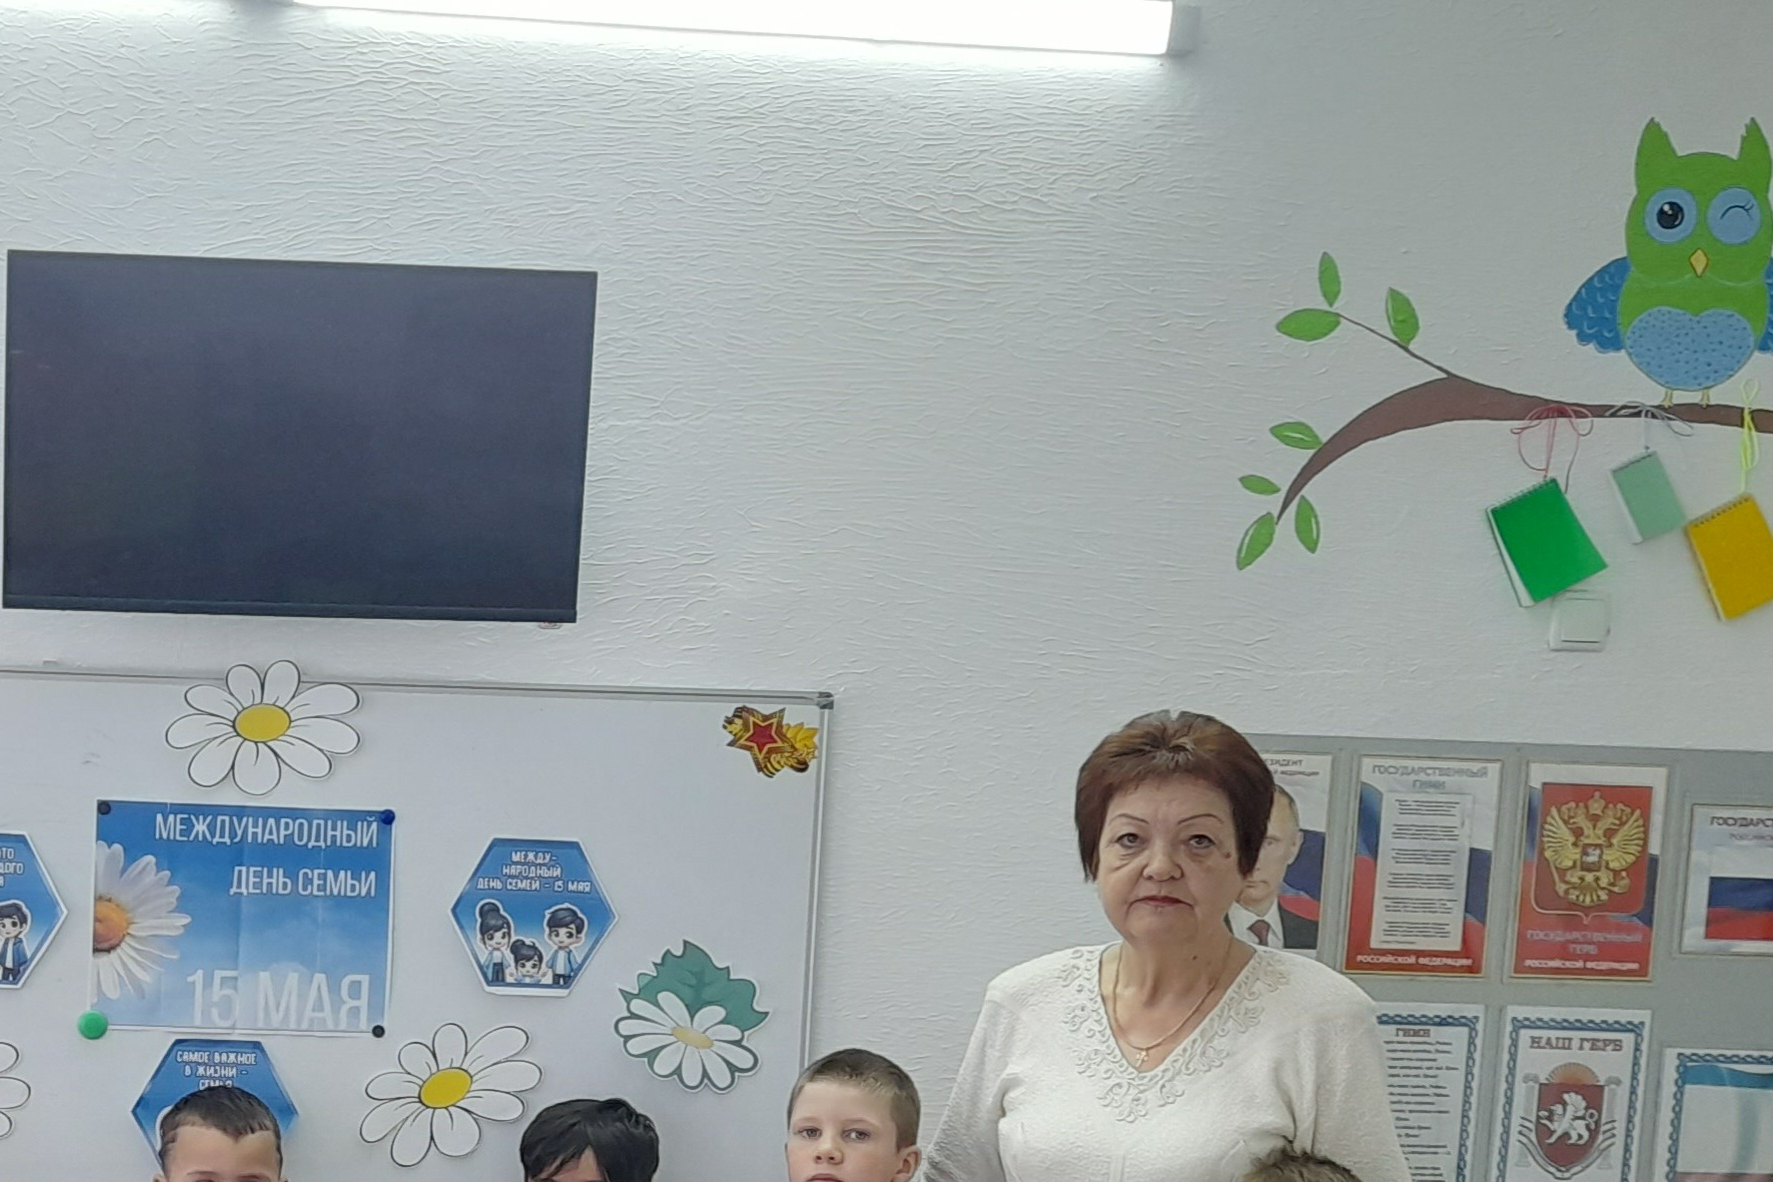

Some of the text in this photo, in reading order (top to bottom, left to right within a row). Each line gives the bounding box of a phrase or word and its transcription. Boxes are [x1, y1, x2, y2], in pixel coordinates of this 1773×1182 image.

[155, 813, 378, 849] МЕЖДУНАРОДНЫЙ
[511, 851, 558, 863] МЕЖДУ-
[502, 865, 561, 878] НАРОДНЫЙ
[230, 866, 376, 897] ДЕНЬ СЕМЬИ
[477, 878, 503, 890] ДЕНЬ
[506, 877, 540, 891] СЕМЕЙ
[553, 881, 564, 891] 15
[568, 881, 592, 893] МАЯ
[186, 968, 371, 1031] 15 МАЯ
[1529, 1035, 1623, 1052] НАШ ГЕРБ
[176, 1051, 257, 1065] САМОЕ ВАЖНОЕ
[184, 1066, 191, 1076] В
[197, 1065, 237, 1078] ЖИЗНИ
